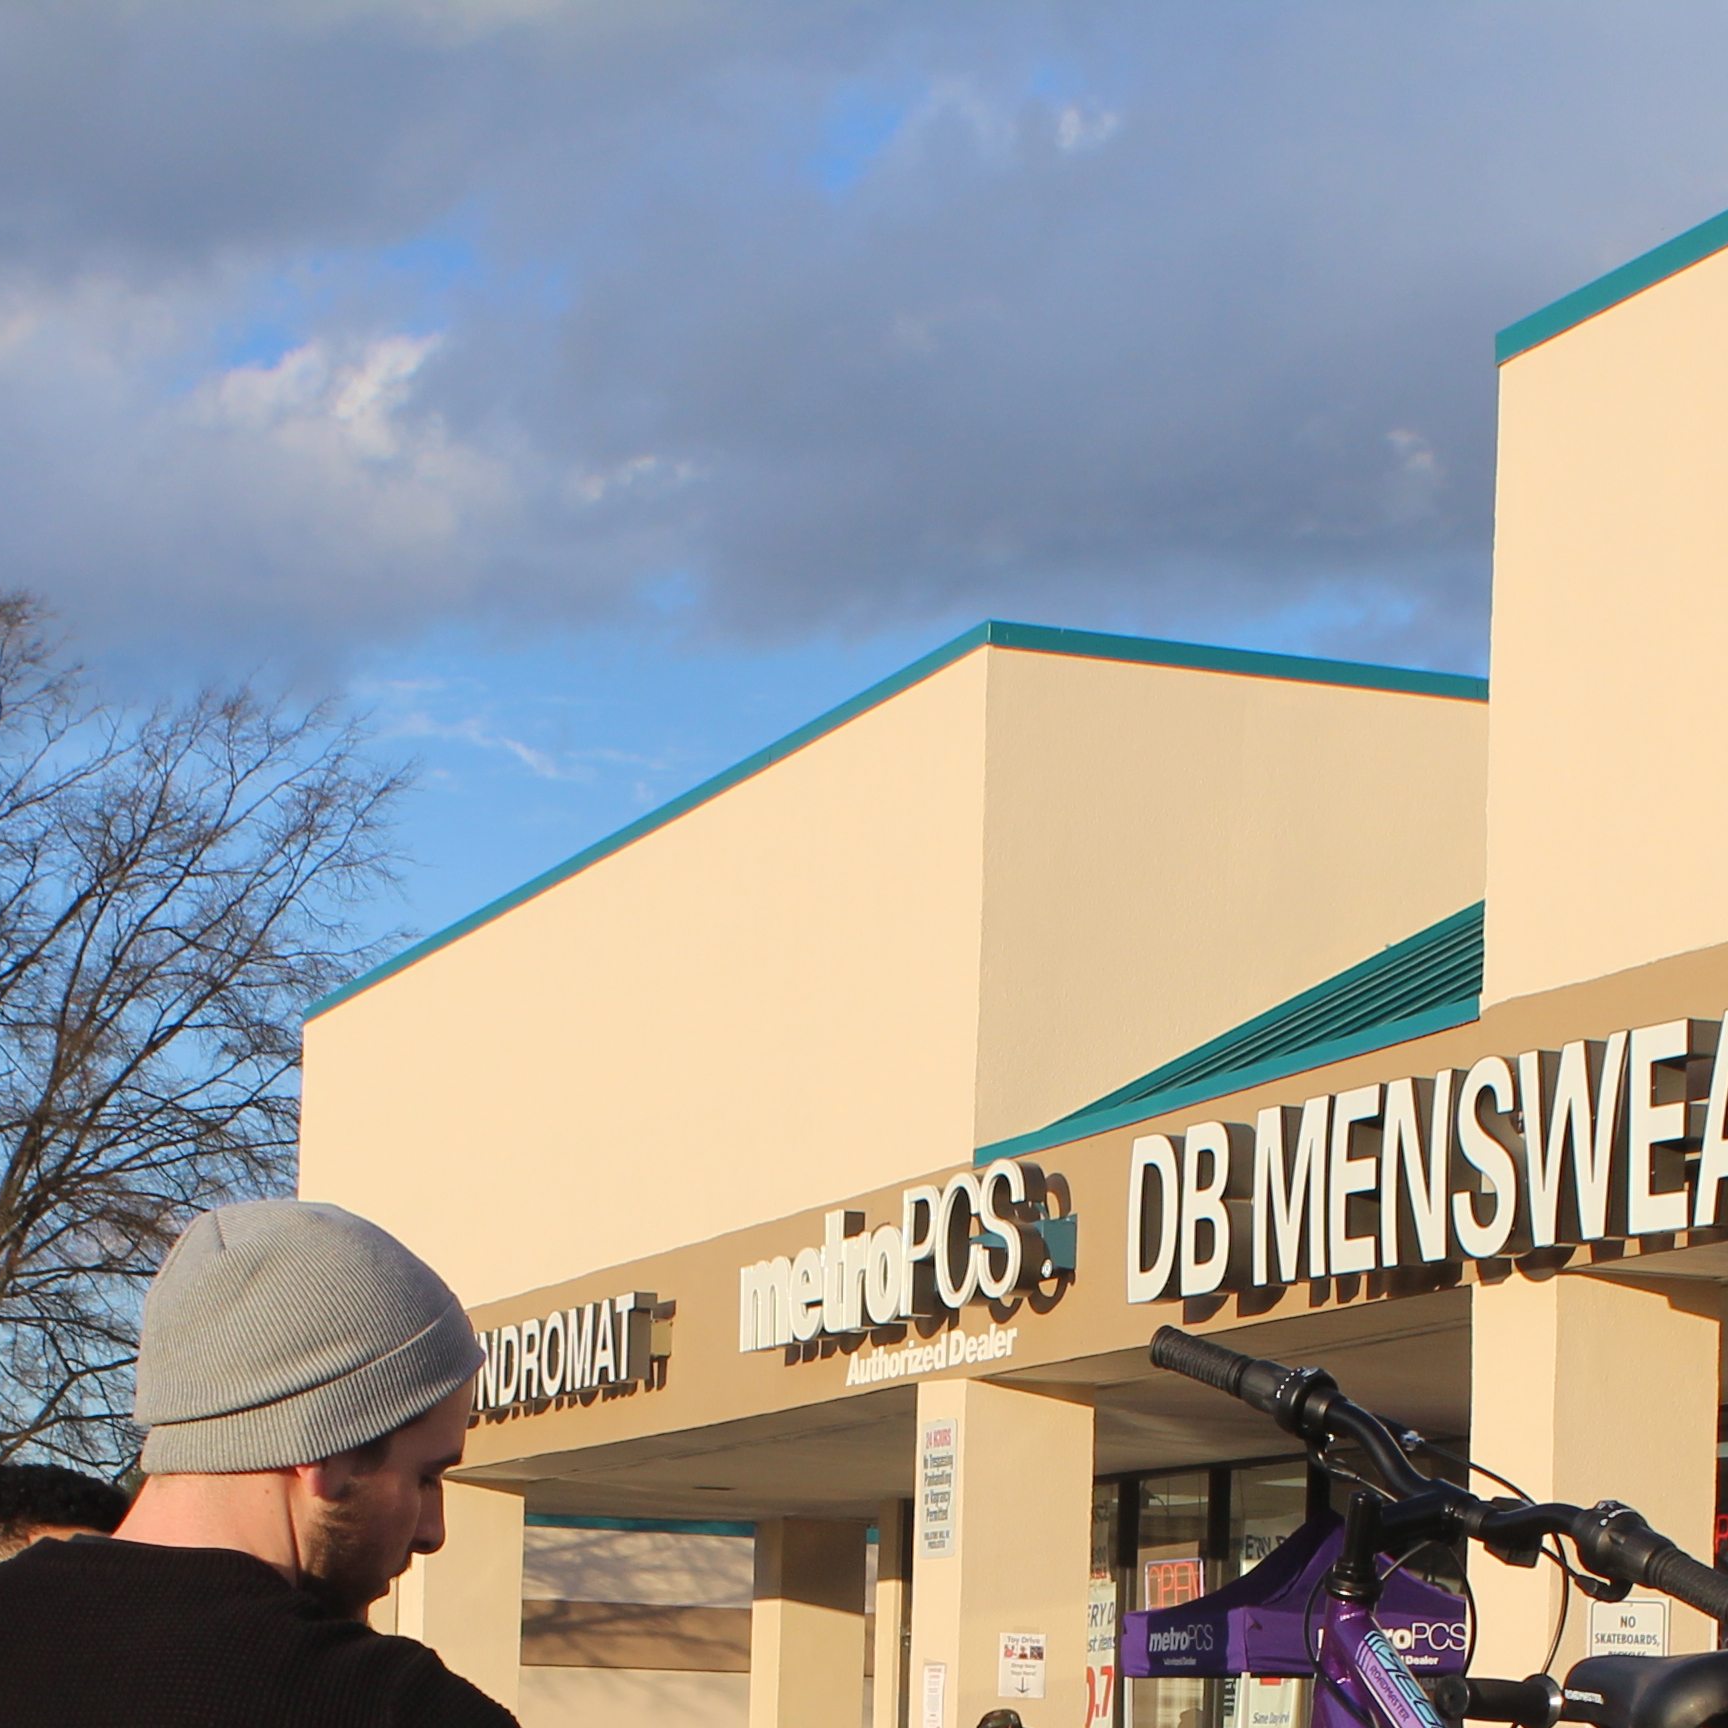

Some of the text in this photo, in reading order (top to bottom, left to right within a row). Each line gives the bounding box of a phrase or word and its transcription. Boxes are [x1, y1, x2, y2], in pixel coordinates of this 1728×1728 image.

[1127, 1120, 1231, 1304] DB
[739, 1157, 1026, 1353] metroPCS
[475, 1290, 637, 1412] NDROMAT
[845, 1323, 1018, 1387] Authorized Dealer
[1148, 1623, 1214, 1652] metroPCS
[1594, 1632, 1661, 1647] SKATEBOARDS,
[1620, 1615, 1636, 1629] NO
[1405, 1655, 1440, 1666] Dealer
[1369, 1664, 1411, 1723] ROADMASTER
